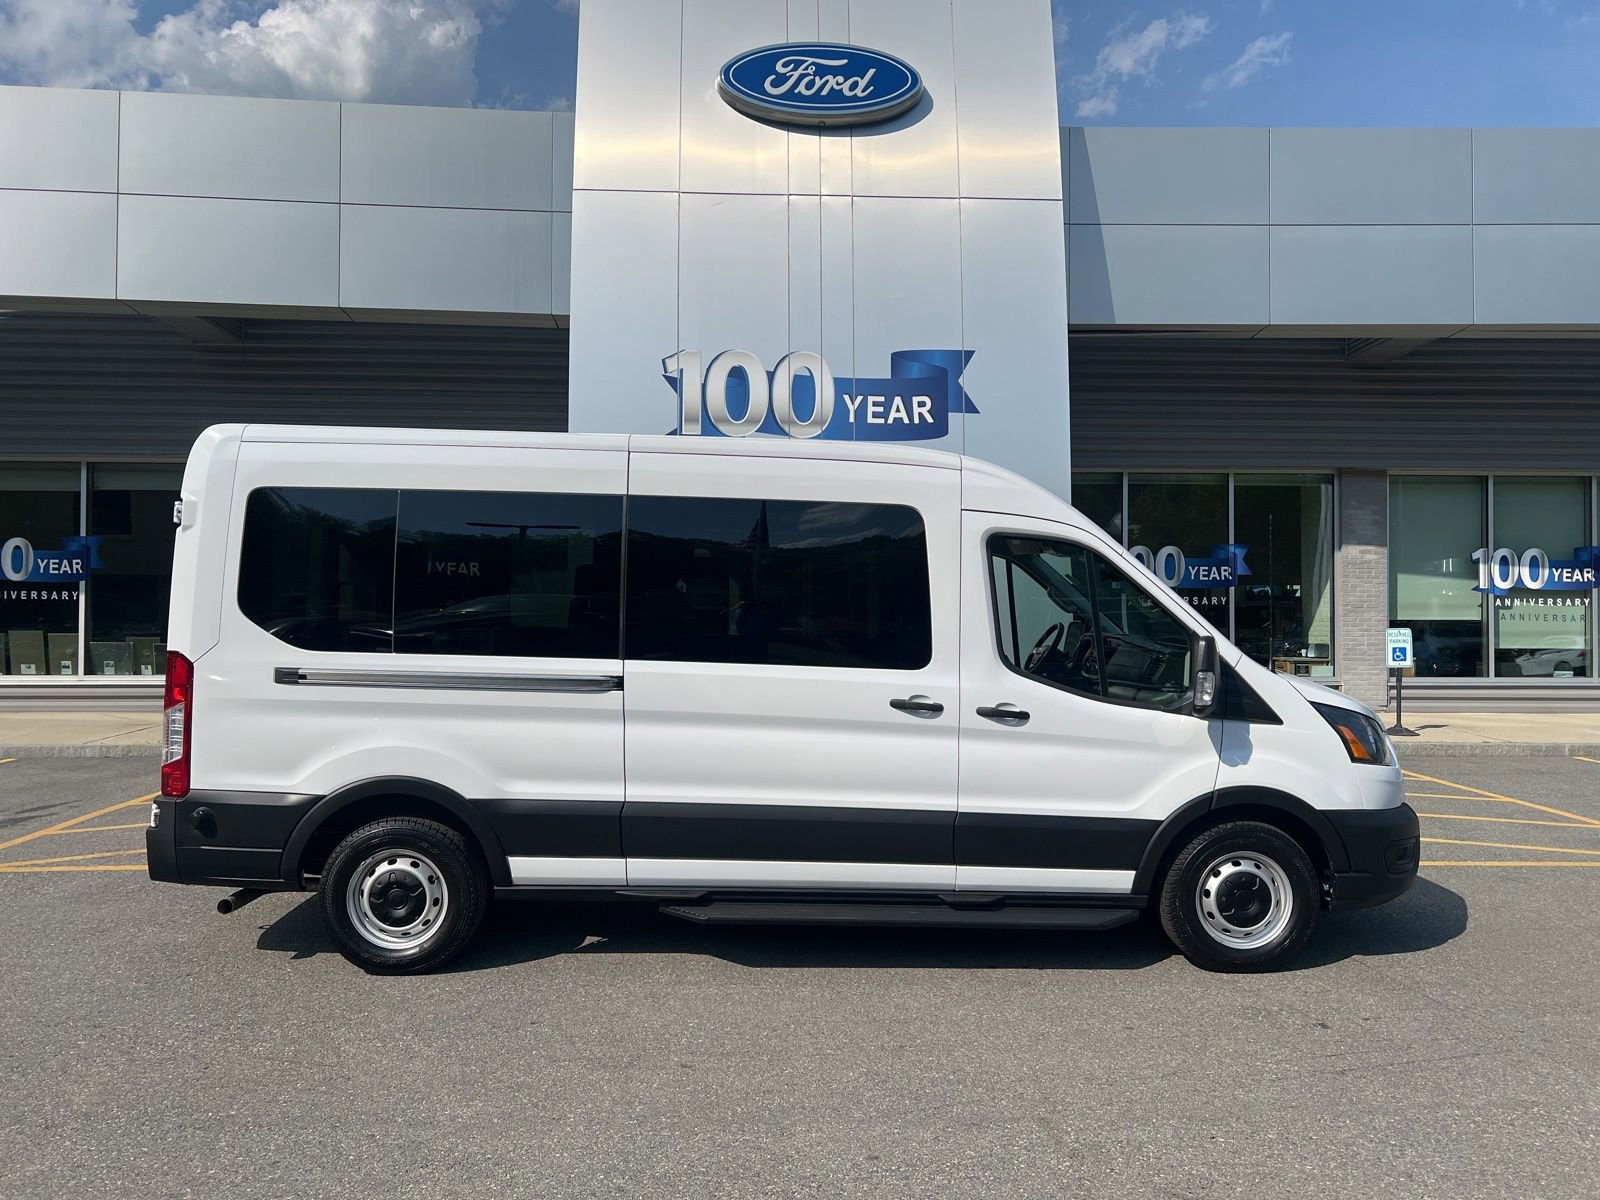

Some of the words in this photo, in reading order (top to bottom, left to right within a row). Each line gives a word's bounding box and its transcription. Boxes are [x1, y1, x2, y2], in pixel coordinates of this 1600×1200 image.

[763, 56, 876, 98] Ford
[662, 349, 835, 438] 100
[843, 394, 934, 424] YEAR
[37, 559, 83, 574] YEAR
[1188, 566, 1233, 580] YEAR
[1471, 547, 1549, 589] 100
[1552, 568, 1596, 582] YEAR
[0, 591, 78, 600] IVERSARY
[1495, 598, 1590, 607] ANNIVERSARY
